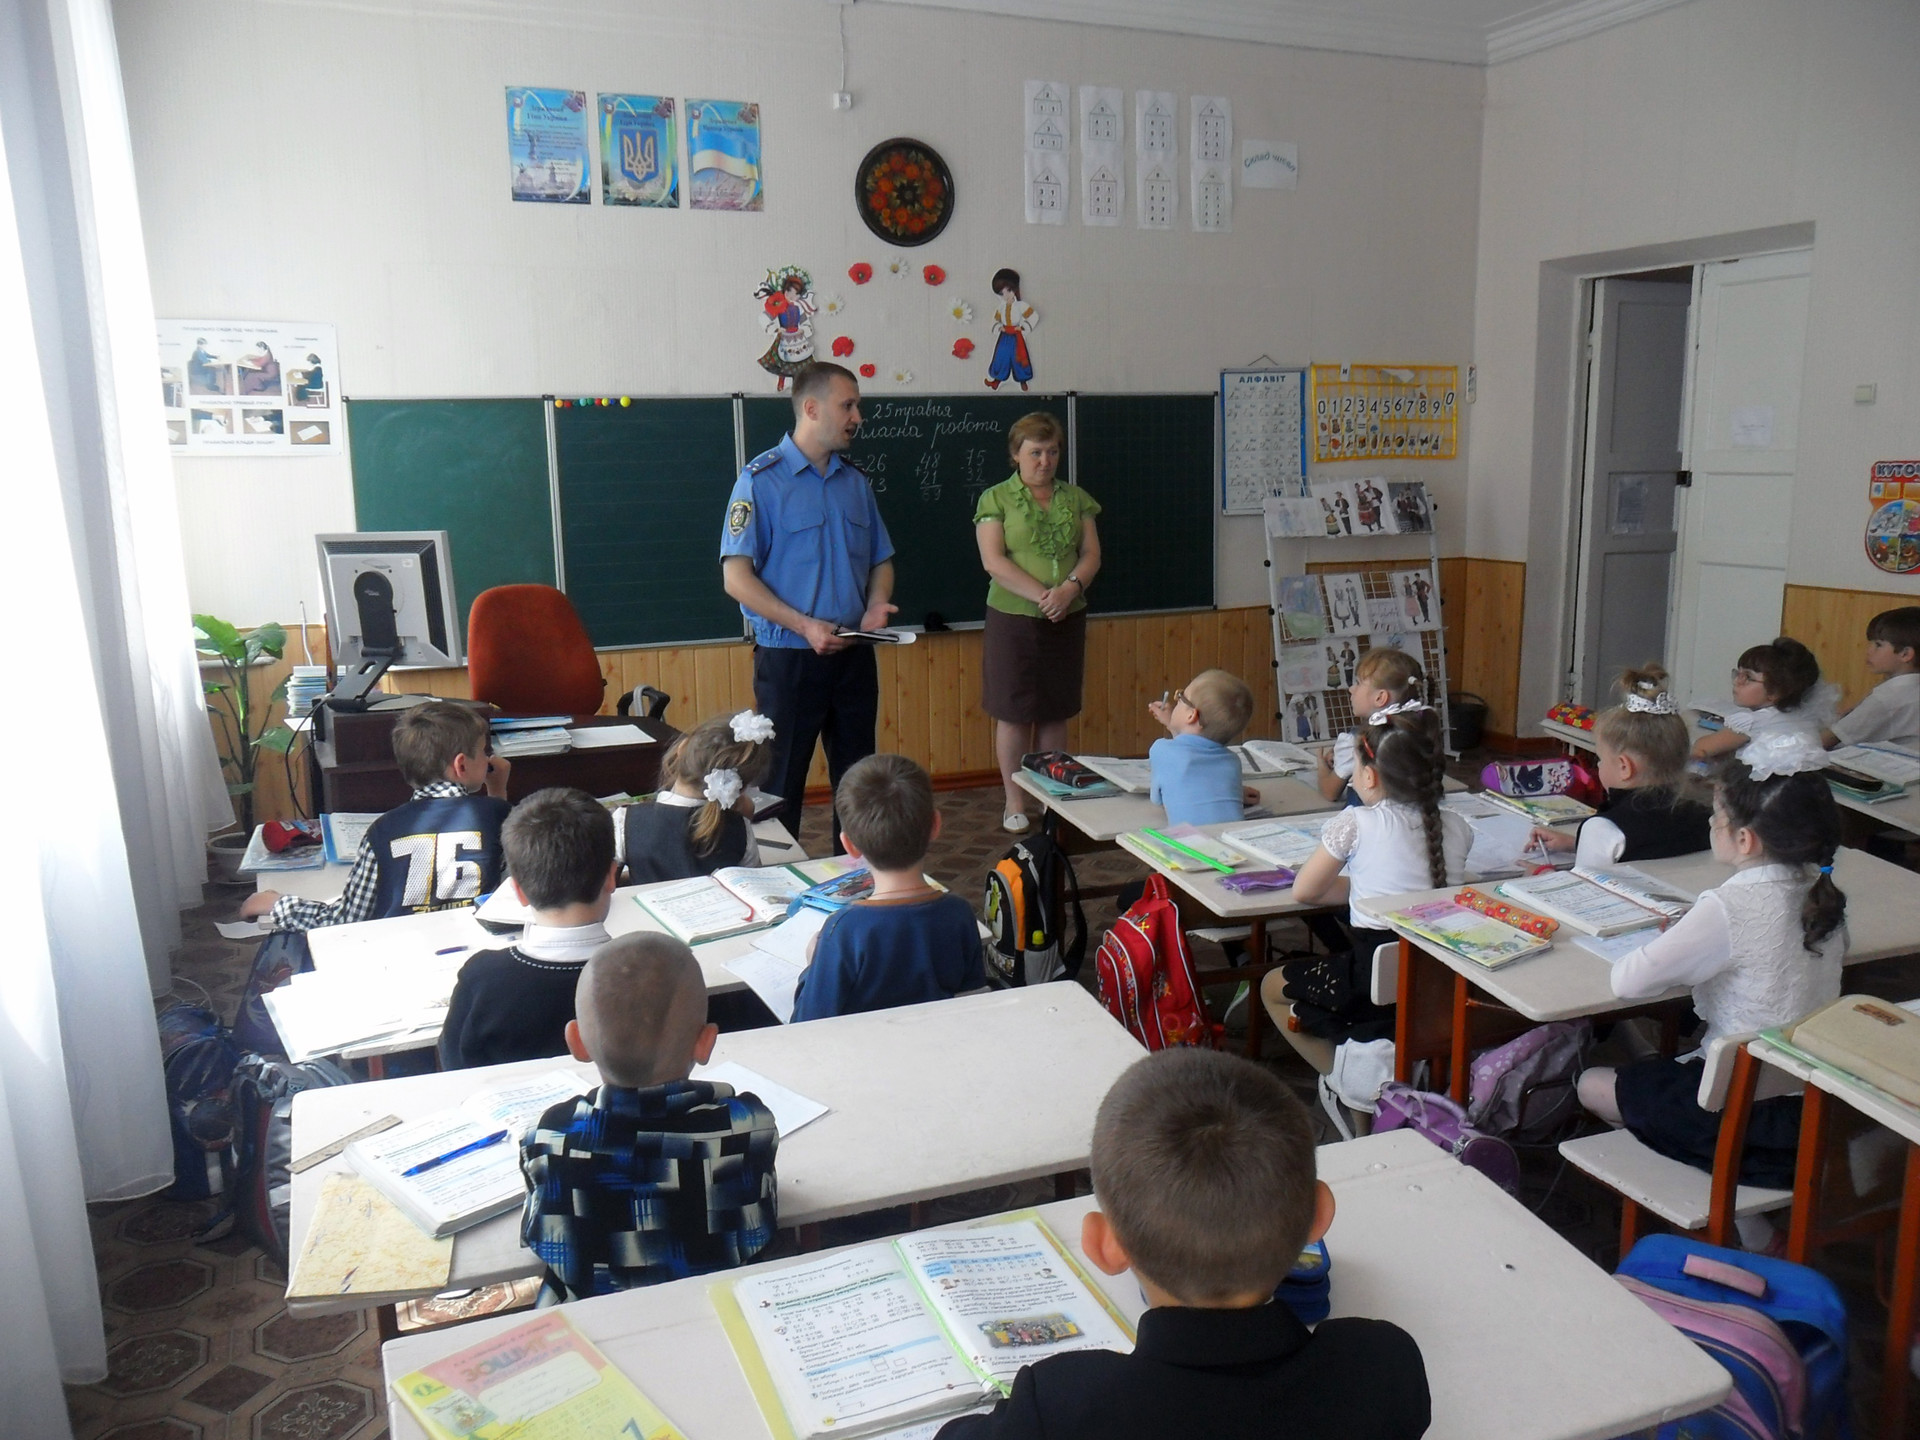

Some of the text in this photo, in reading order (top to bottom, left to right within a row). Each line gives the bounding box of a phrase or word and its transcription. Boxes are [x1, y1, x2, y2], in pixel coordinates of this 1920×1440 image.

[1239, 375, 1286, 384] АЛФАВІТ
[873, 399, 953, 426] 25 травня
[1318, 392, 1454, 414] 0 1 2 3 4 5 6 7 8 9 0
[852, 412, 1002, 449] Класна робота
[866, 453, 887, 472] 26
[920, 452, 940, 470] 48
[920, 470, 937, 486] 21
[390, 832, 482, 906] 76
